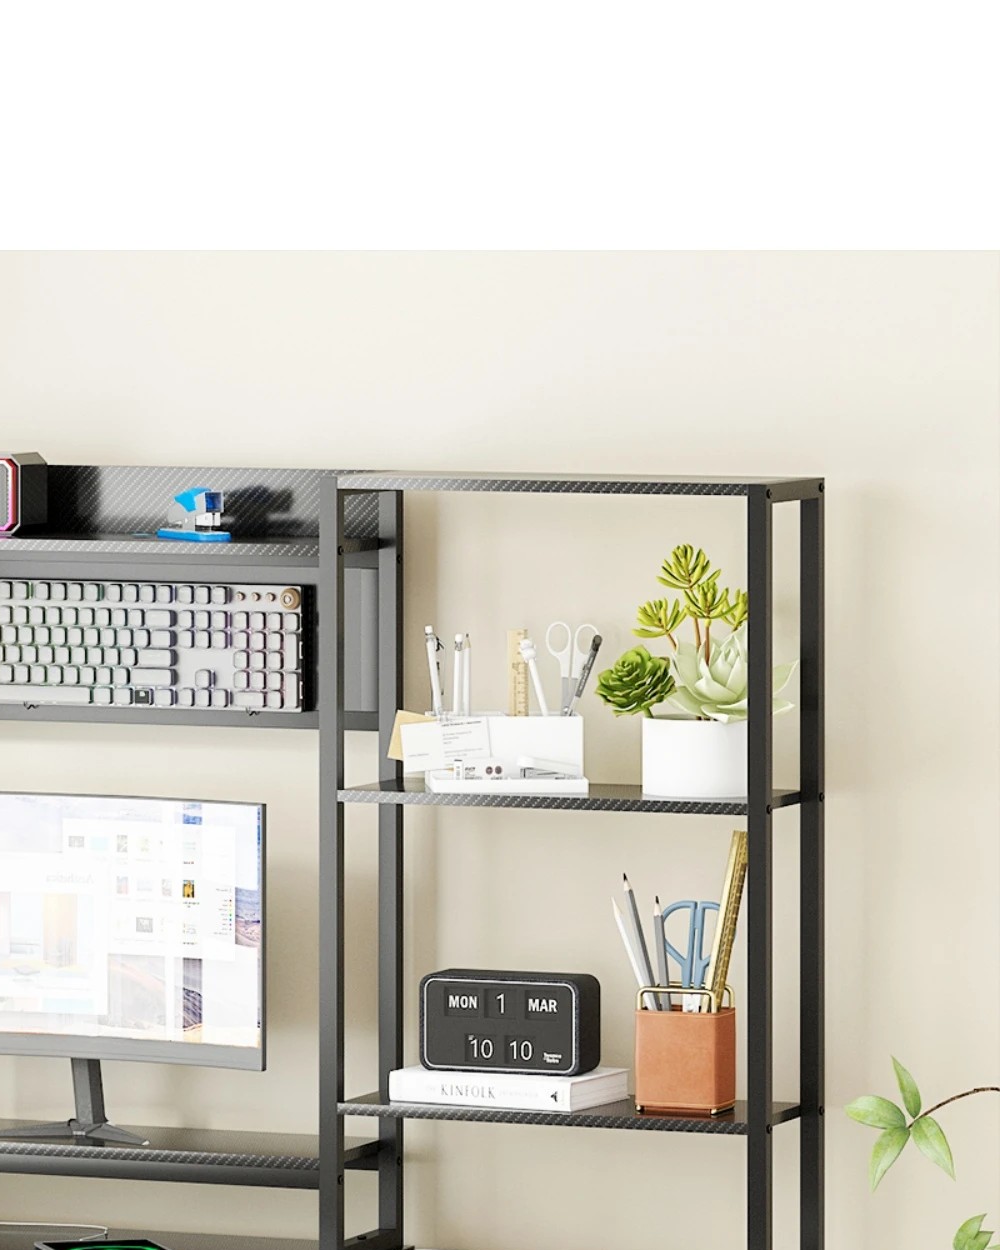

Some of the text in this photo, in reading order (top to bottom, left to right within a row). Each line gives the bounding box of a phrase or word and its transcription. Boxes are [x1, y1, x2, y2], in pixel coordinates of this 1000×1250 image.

[448, 993, 557, 1014] MON 1 MAR
[470, 1038, 493, 1059] 10
[509, 1040, 533, 1061] 10
[440, 1084, 496, 1100] KINFOLK
